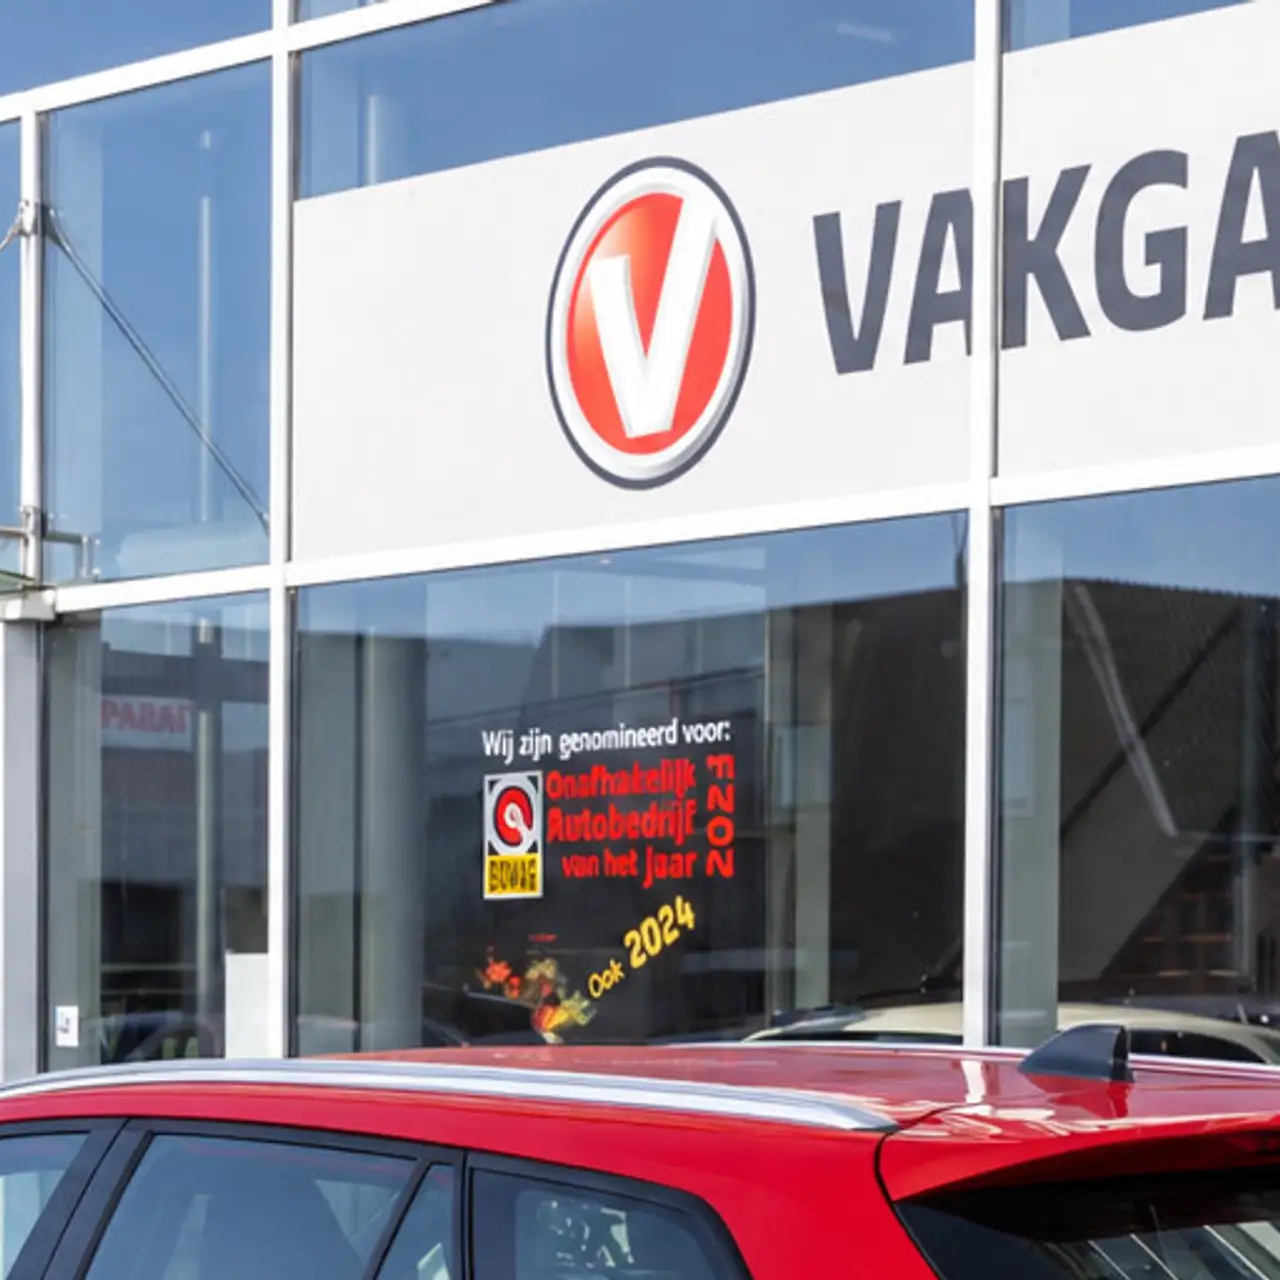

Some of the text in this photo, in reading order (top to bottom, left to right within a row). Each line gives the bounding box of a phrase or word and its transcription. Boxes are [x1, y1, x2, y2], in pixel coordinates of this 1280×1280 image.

[482, 718, 731, 765] Wij zijn genomineerd voor:
[546, 800, 697, 845] Autobedrijf
[604, 849, 638, 877] het
[588, 895, 696, 998] Ook 2024
